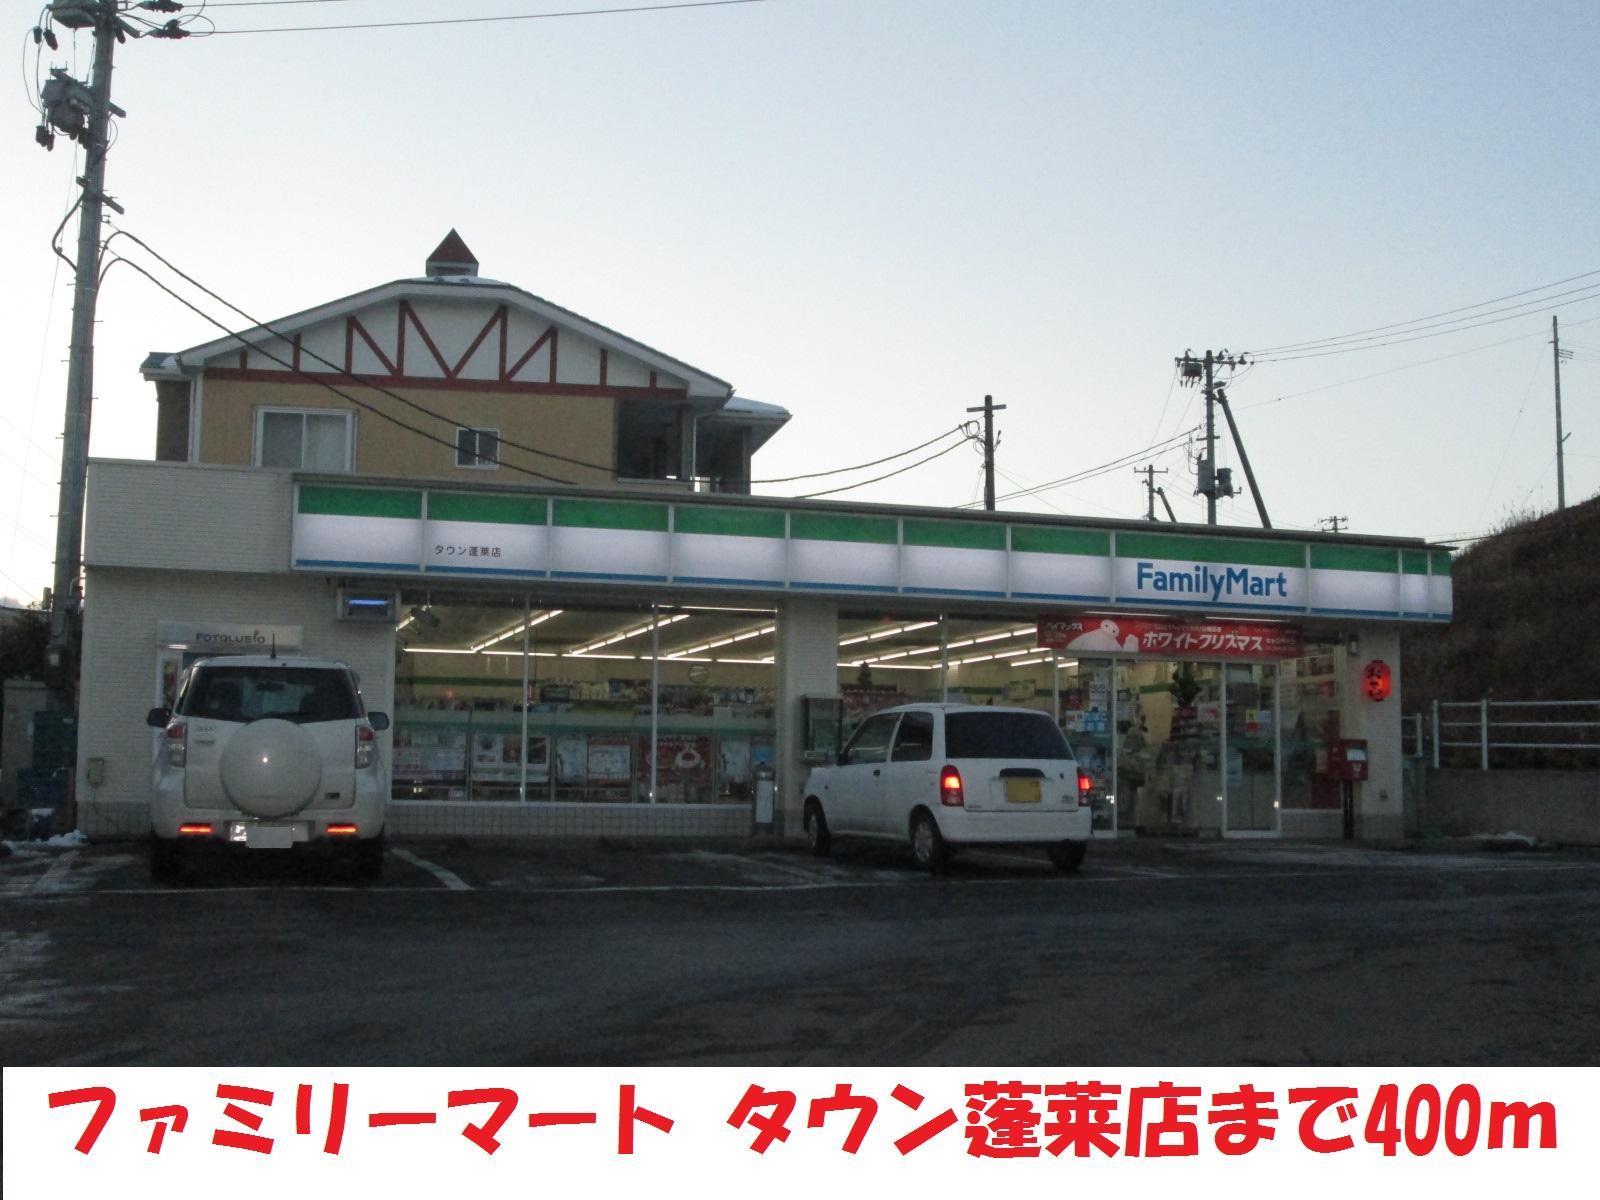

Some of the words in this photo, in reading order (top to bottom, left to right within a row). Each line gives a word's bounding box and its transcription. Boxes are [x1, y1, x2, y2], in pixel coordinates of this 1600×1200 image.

[434, 545, 502, 558] タウン蓬莱店
[1137, 562, 1287, 602] FamilyMart
